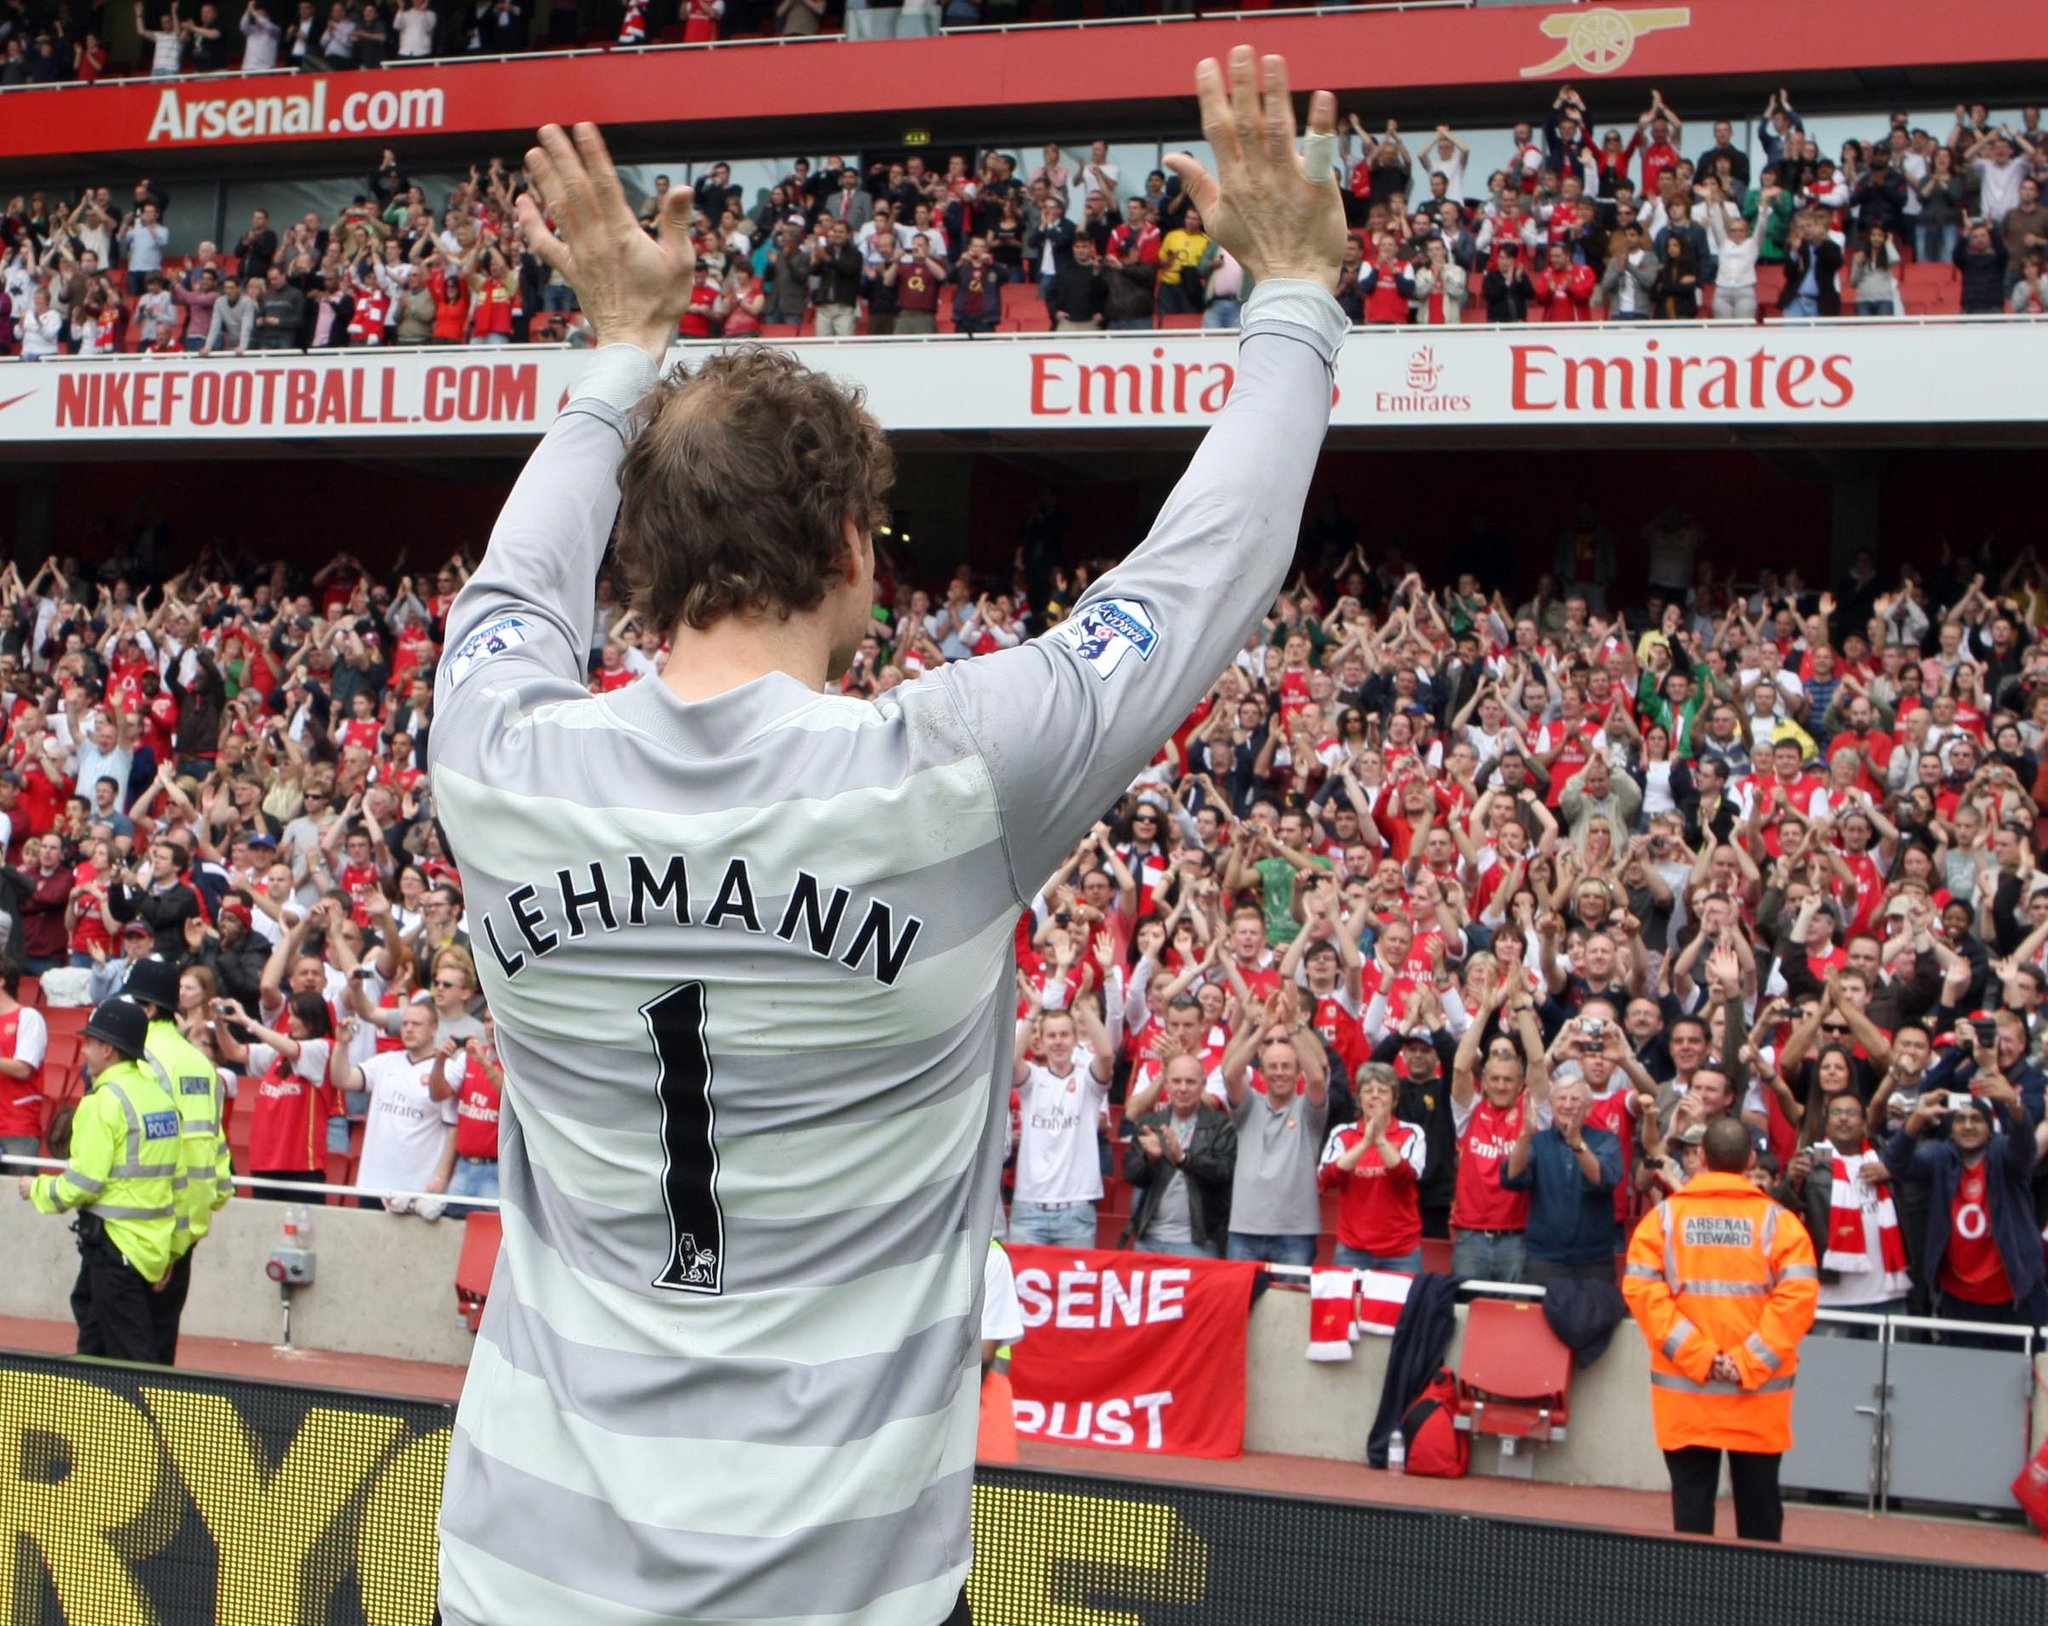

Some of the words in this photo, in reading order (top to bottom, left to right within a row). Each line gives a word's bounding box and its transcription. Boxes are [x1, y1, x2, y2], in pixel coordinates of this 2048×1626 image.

[147, 79, 445, 142] Arsenal.com
[55, 363, 538, 428] NIKEFOOTBALL.COM
[1029, 346, 1339, 416] Emira
[1375, 391, 1471, 413] Emirates
[1510, 339, 1854, 412] Emirates
[482, 854, 924, 988] LEHMANN
[638, 979, 725, 1295] 1
[1685, 1231, 1751, 1245] STEWARD
[1686, 1218, 1751, 1231] ARSENAL
